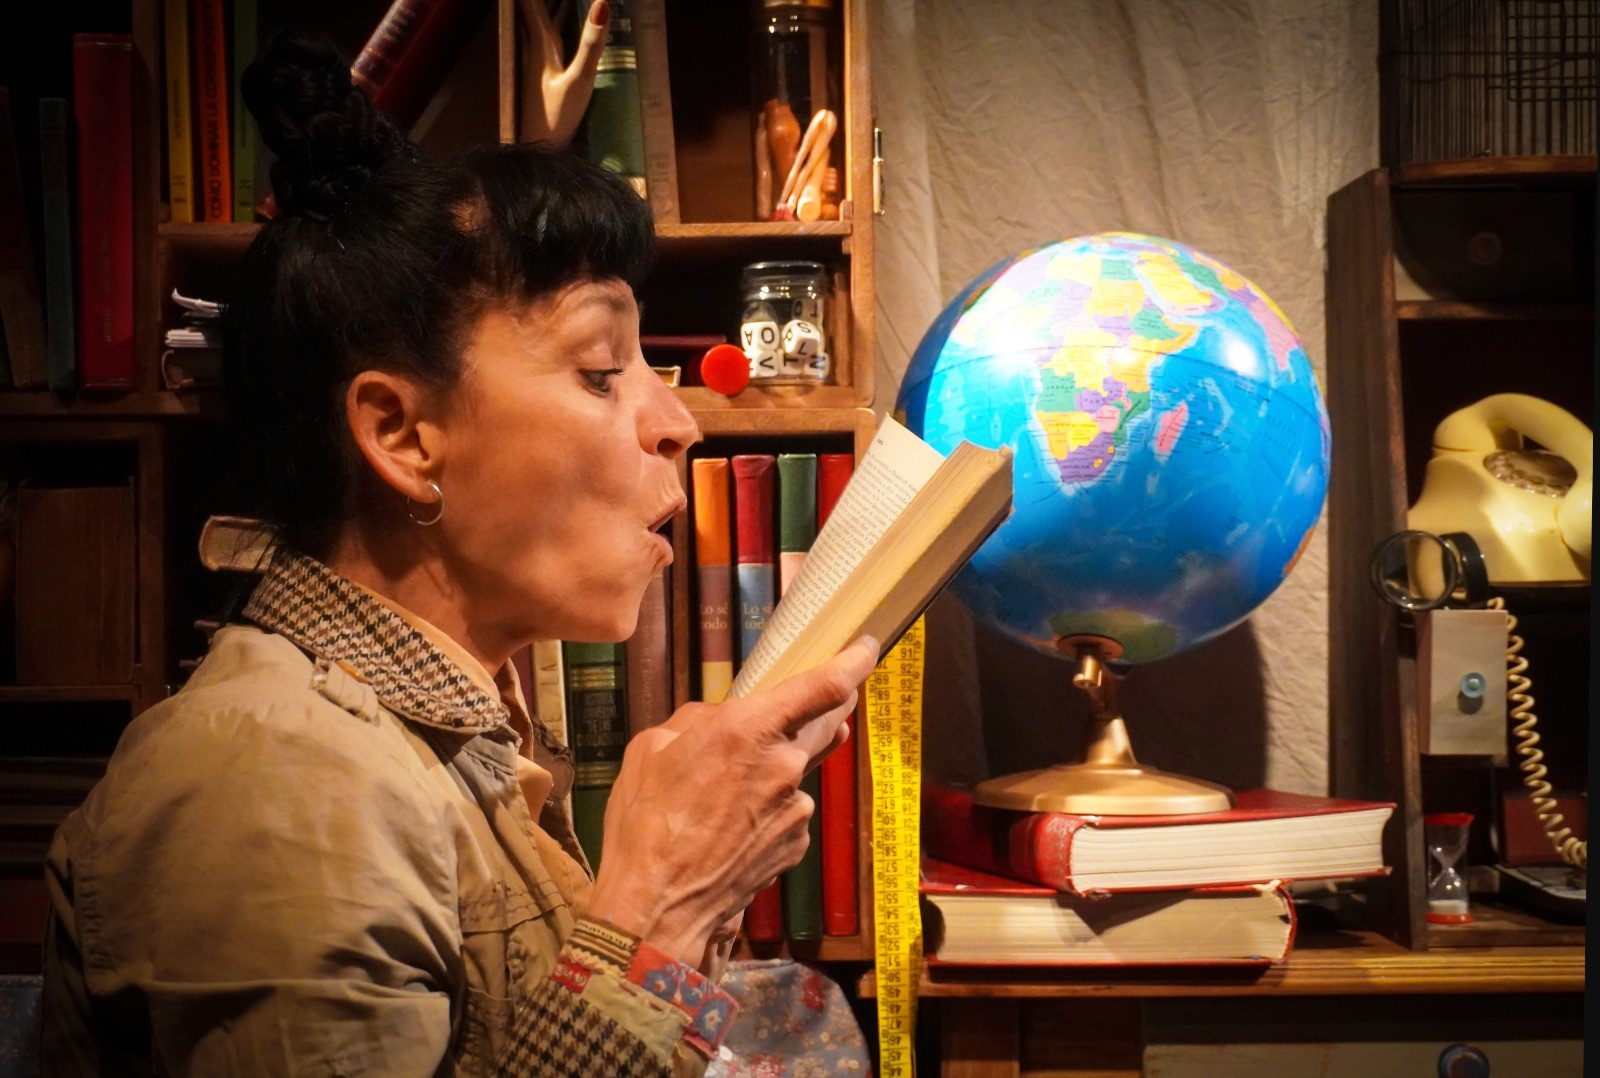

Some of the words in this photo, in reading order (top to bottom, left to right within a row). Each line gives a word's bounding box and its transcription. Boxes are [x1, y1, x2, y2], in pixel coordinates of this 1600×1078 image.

[206, 103, 218, 117] LA
[207, 120, 221, 177] DOMINAR
[209, 180, 223, 219] COMO
[761, 327, 775, 344] O
[901, 648, 912, 659] 91
[901, 663, 913, 674] 92
[877, 675, 889, 685] 69
[901, 678, 912, 689] 93
[878, 690, 890, 701] 68
[901, 694, 912, 705] 94
[879, 705, 891, 717] 67
[901, 710, 912, 720] 95
[880, 721, 892, 732] 66
[881, 736, 893, 747] 65
[901, 740, 911, 752] 97
[881, 752, 893, 763] 64
[882, 767, 894, 779] 63
[883, 783, 895, 794] 62
[884, 799, 895, 810] 61
[884, 815, 896, 826] 60
[885, 830, 897, 841] 59
[885, 846, 897, 857] 58
[886, 861, 898, 873] 57
[886, 877, 898, 889] 56
[886, 893, 899, 904] 55
[886, 908, 899, 920] 54
[887, 925, 899, 936] 53
[887, 940, 900, 951] 52
[888, 956, 901, 967] 51
[888, 972, 901, 983] 50
[889, 988, 901, 999] 49
[889, 1003, 902, 1015] 48
